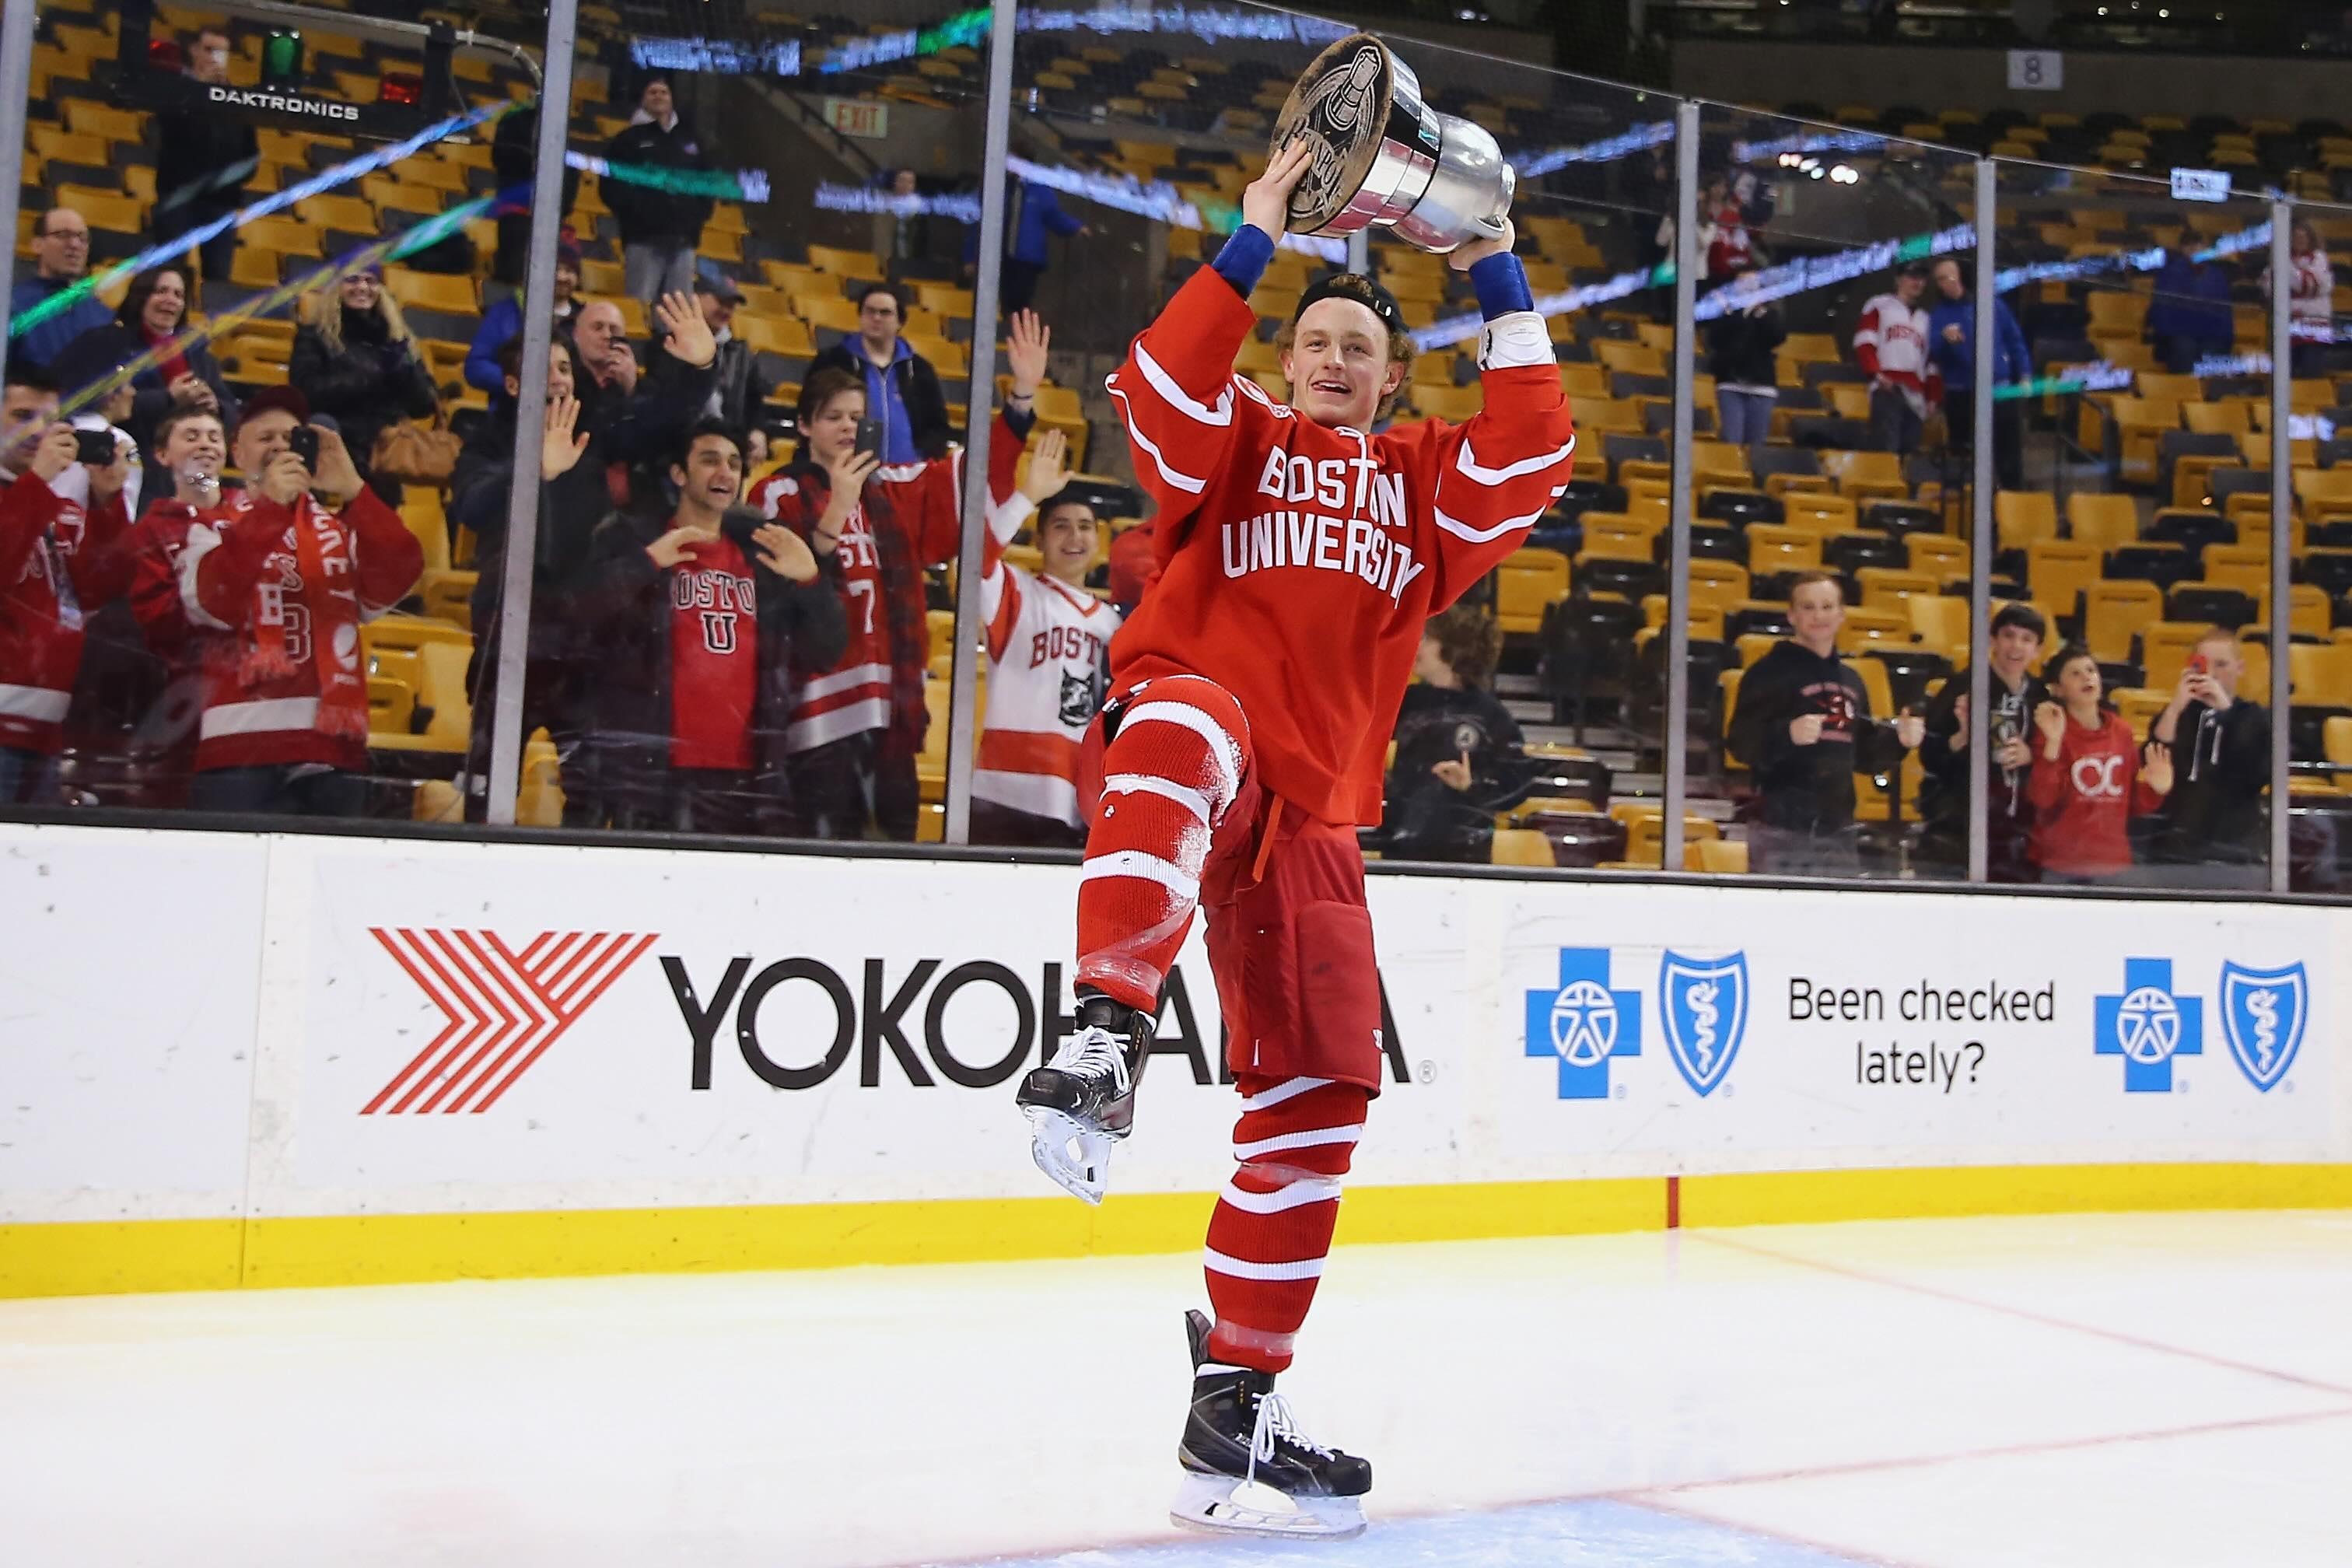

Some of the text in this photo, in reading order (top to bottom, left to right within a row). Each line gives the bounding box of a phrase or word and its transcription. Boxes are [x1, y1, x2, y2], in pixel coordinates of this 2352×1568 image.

[2025, 57, 2042, 85] 8
[209, 86, 359, 121] DAKTRONICS
[835, 103, 878, 132] EXIT
[1223, 510, 1425, 610] UNIVERSITY
[847, 578, 876, 635] 7
[699, 610, 737, 655] U
[1789, 978, 2054, 1022] Been checked
[1857, 1041, 1985, 1094] lately?
